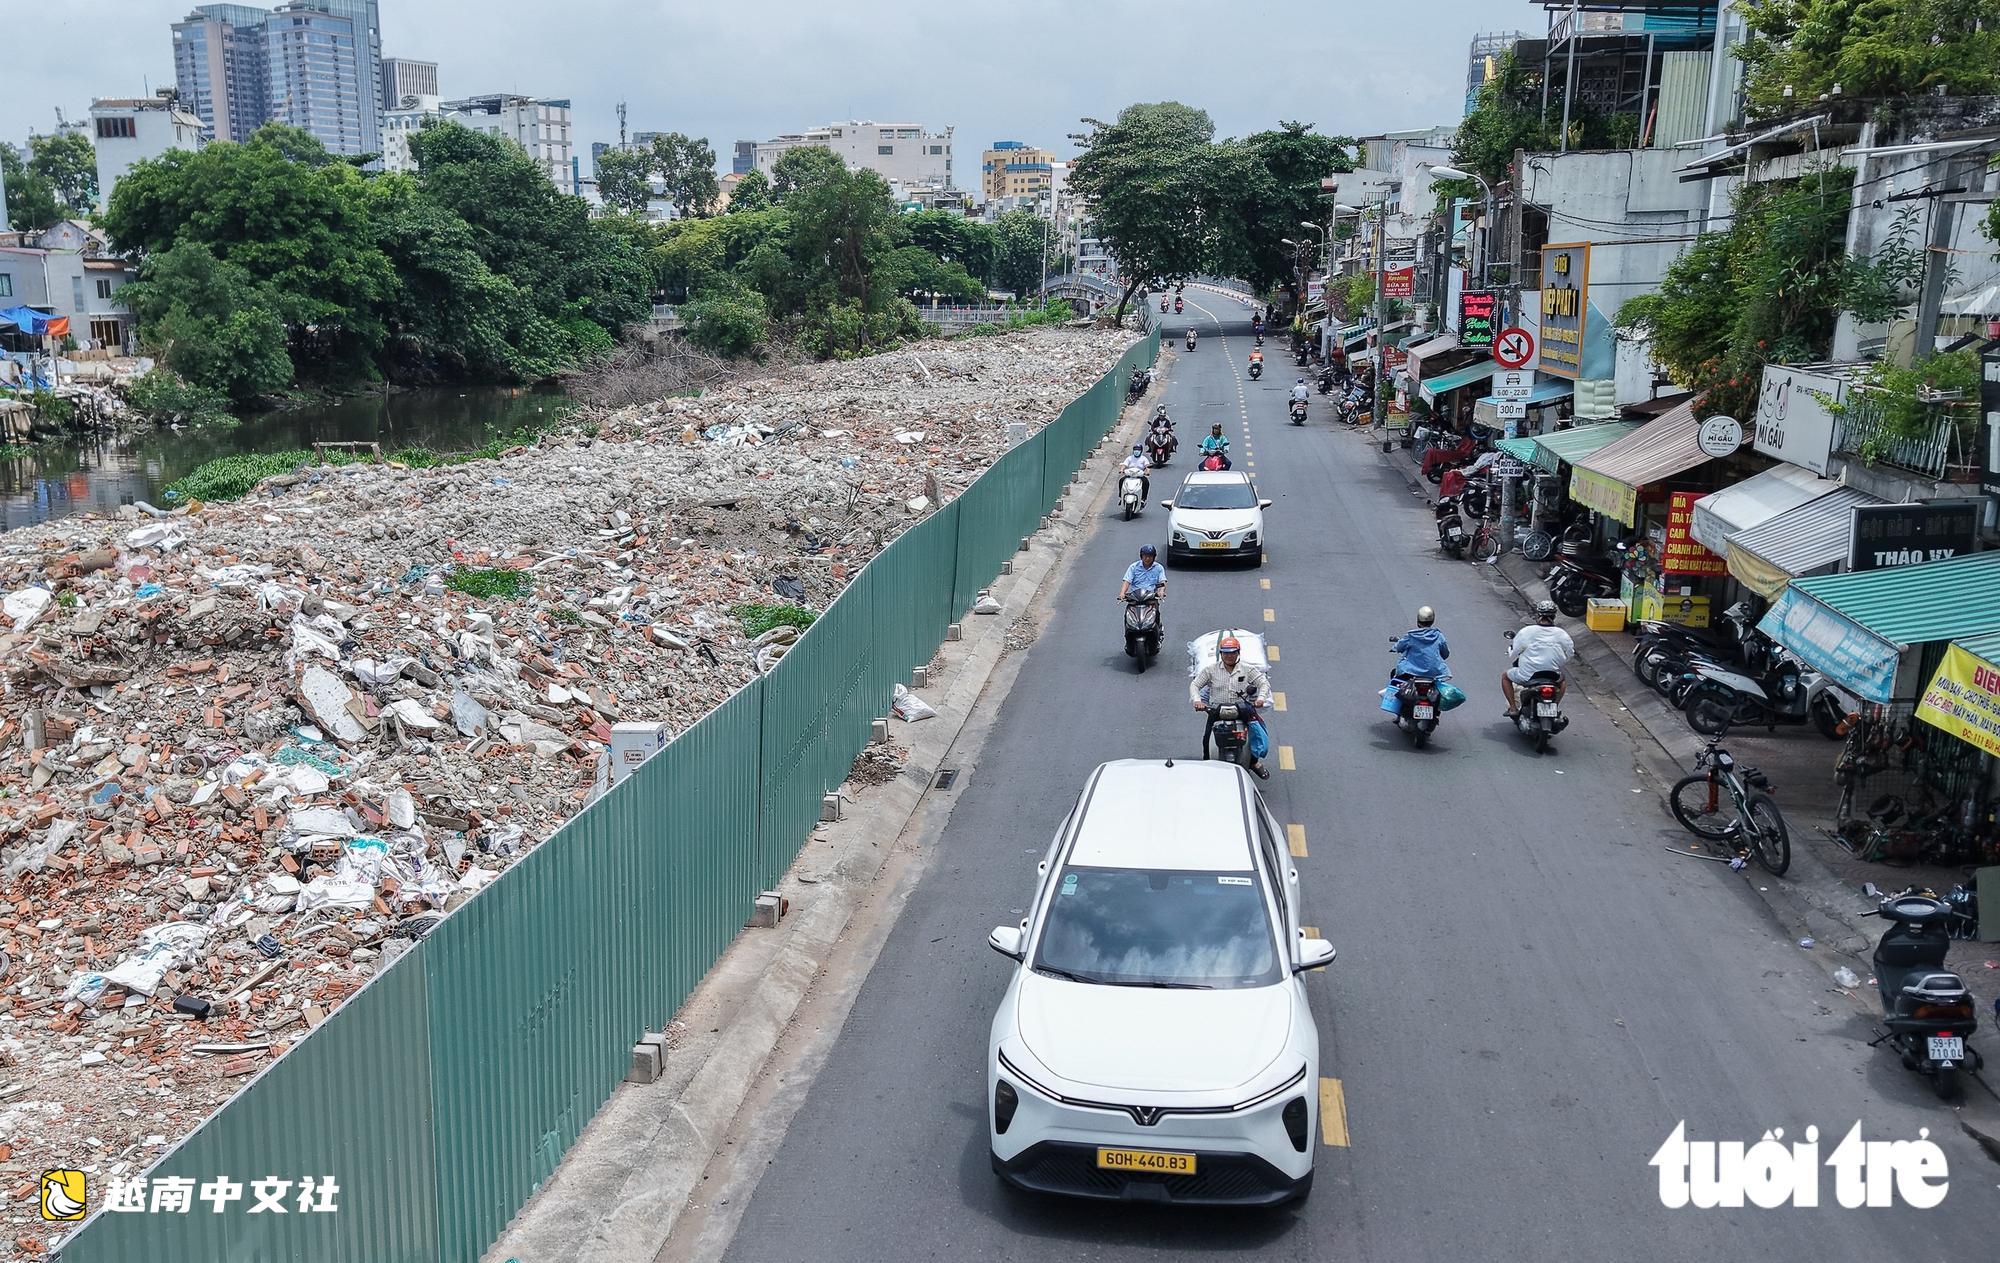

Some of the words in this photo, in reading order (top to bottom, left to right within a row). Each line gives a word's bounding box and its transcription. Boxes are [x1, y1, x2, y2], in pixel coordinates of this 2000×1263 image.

[1462, 331, 1491, 343] Salon
[1500, 405, 1515, 414] 300
[1717, 433, 1733, 442] GÂU
[1758, 420, 1769, 444] MÍ
[1768, 423, 1785, 449] GÂU
[1669, 528, 1685, 539] CAM
[1667, 543, 1691, 555] CHANH
[1874, 547, 1923, 566] THẢO
[1963, 689, 1977, 704] CHO
[1106, 1152, 1187, 1170] 60H-440.83
